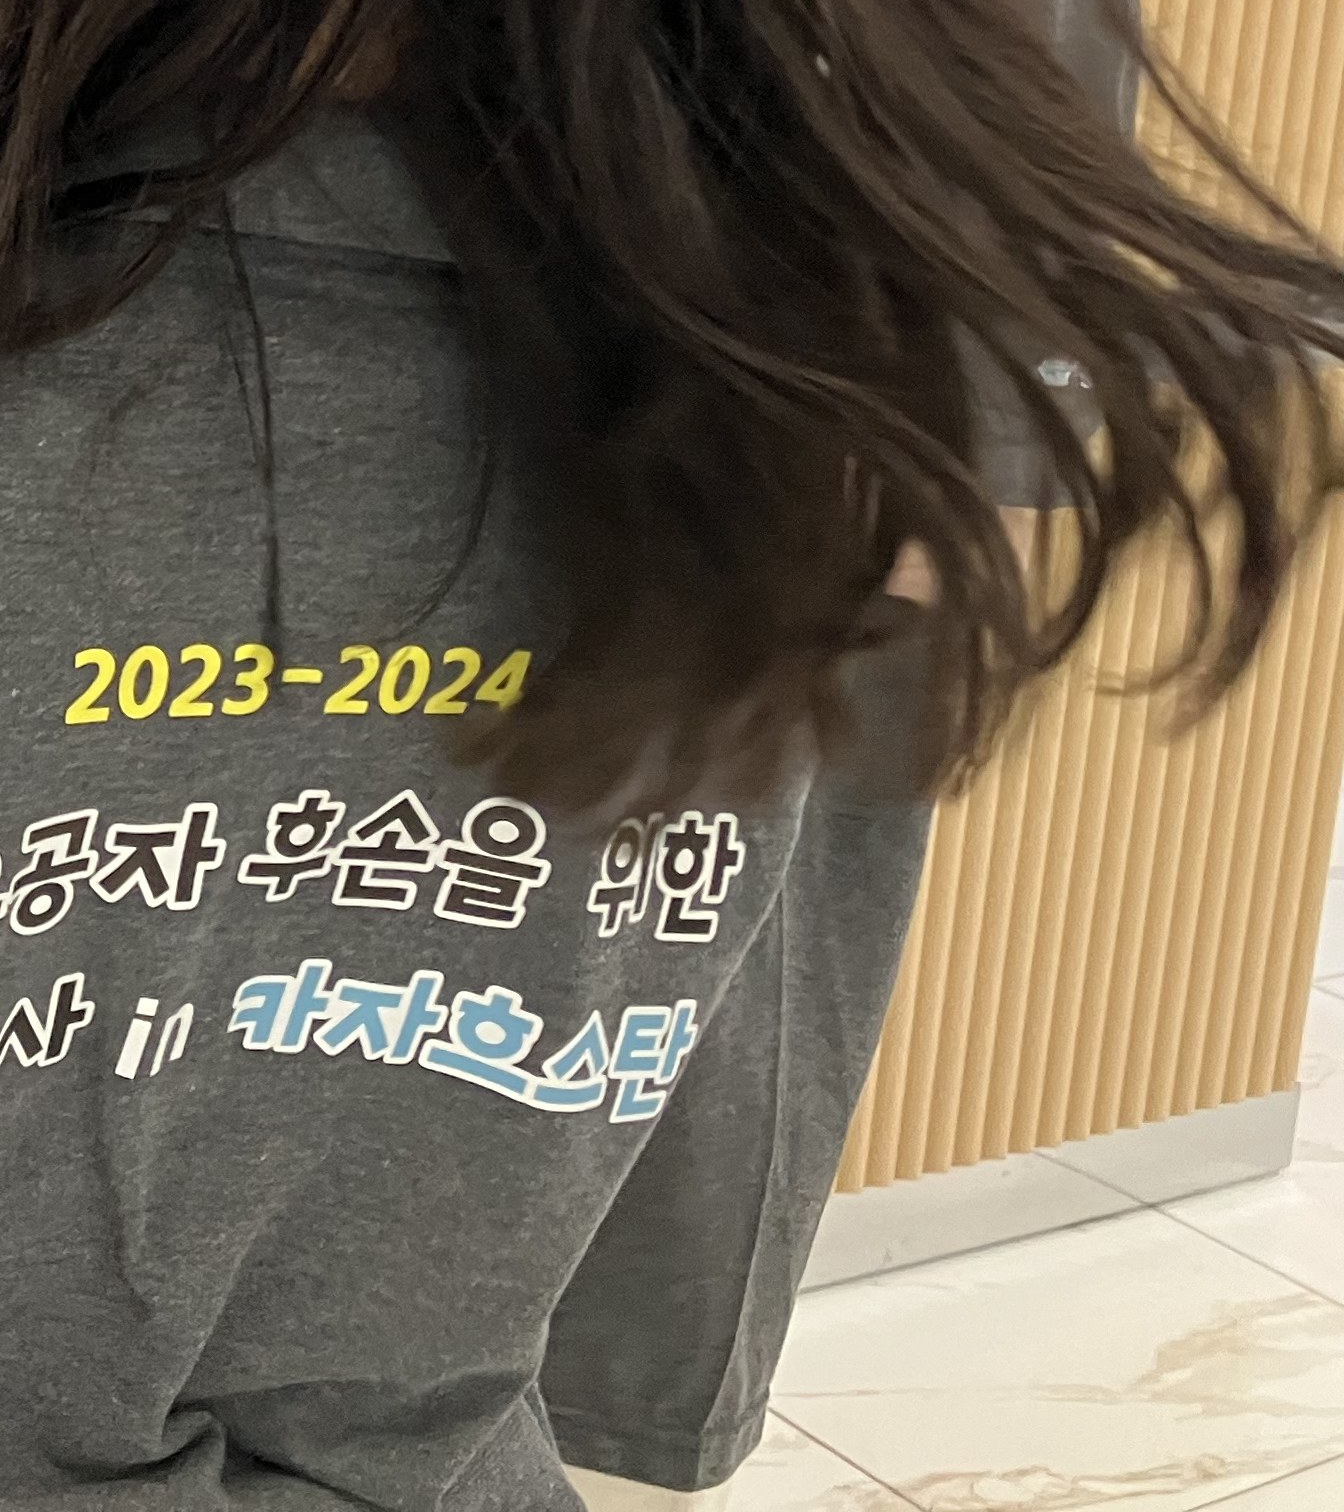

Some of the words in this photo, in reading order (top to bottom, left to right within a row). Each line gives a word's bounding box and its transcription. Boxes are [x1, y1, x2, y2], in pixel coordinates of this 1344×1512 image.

[64, 643, 534, 725] 2023-2024
[237, 789, 552, 928] 후손을
[587, 810, 748, 942] 위한
[114, 996, 195, 1080] in
[228, 958, 699, 1123] 카자흐스탄
